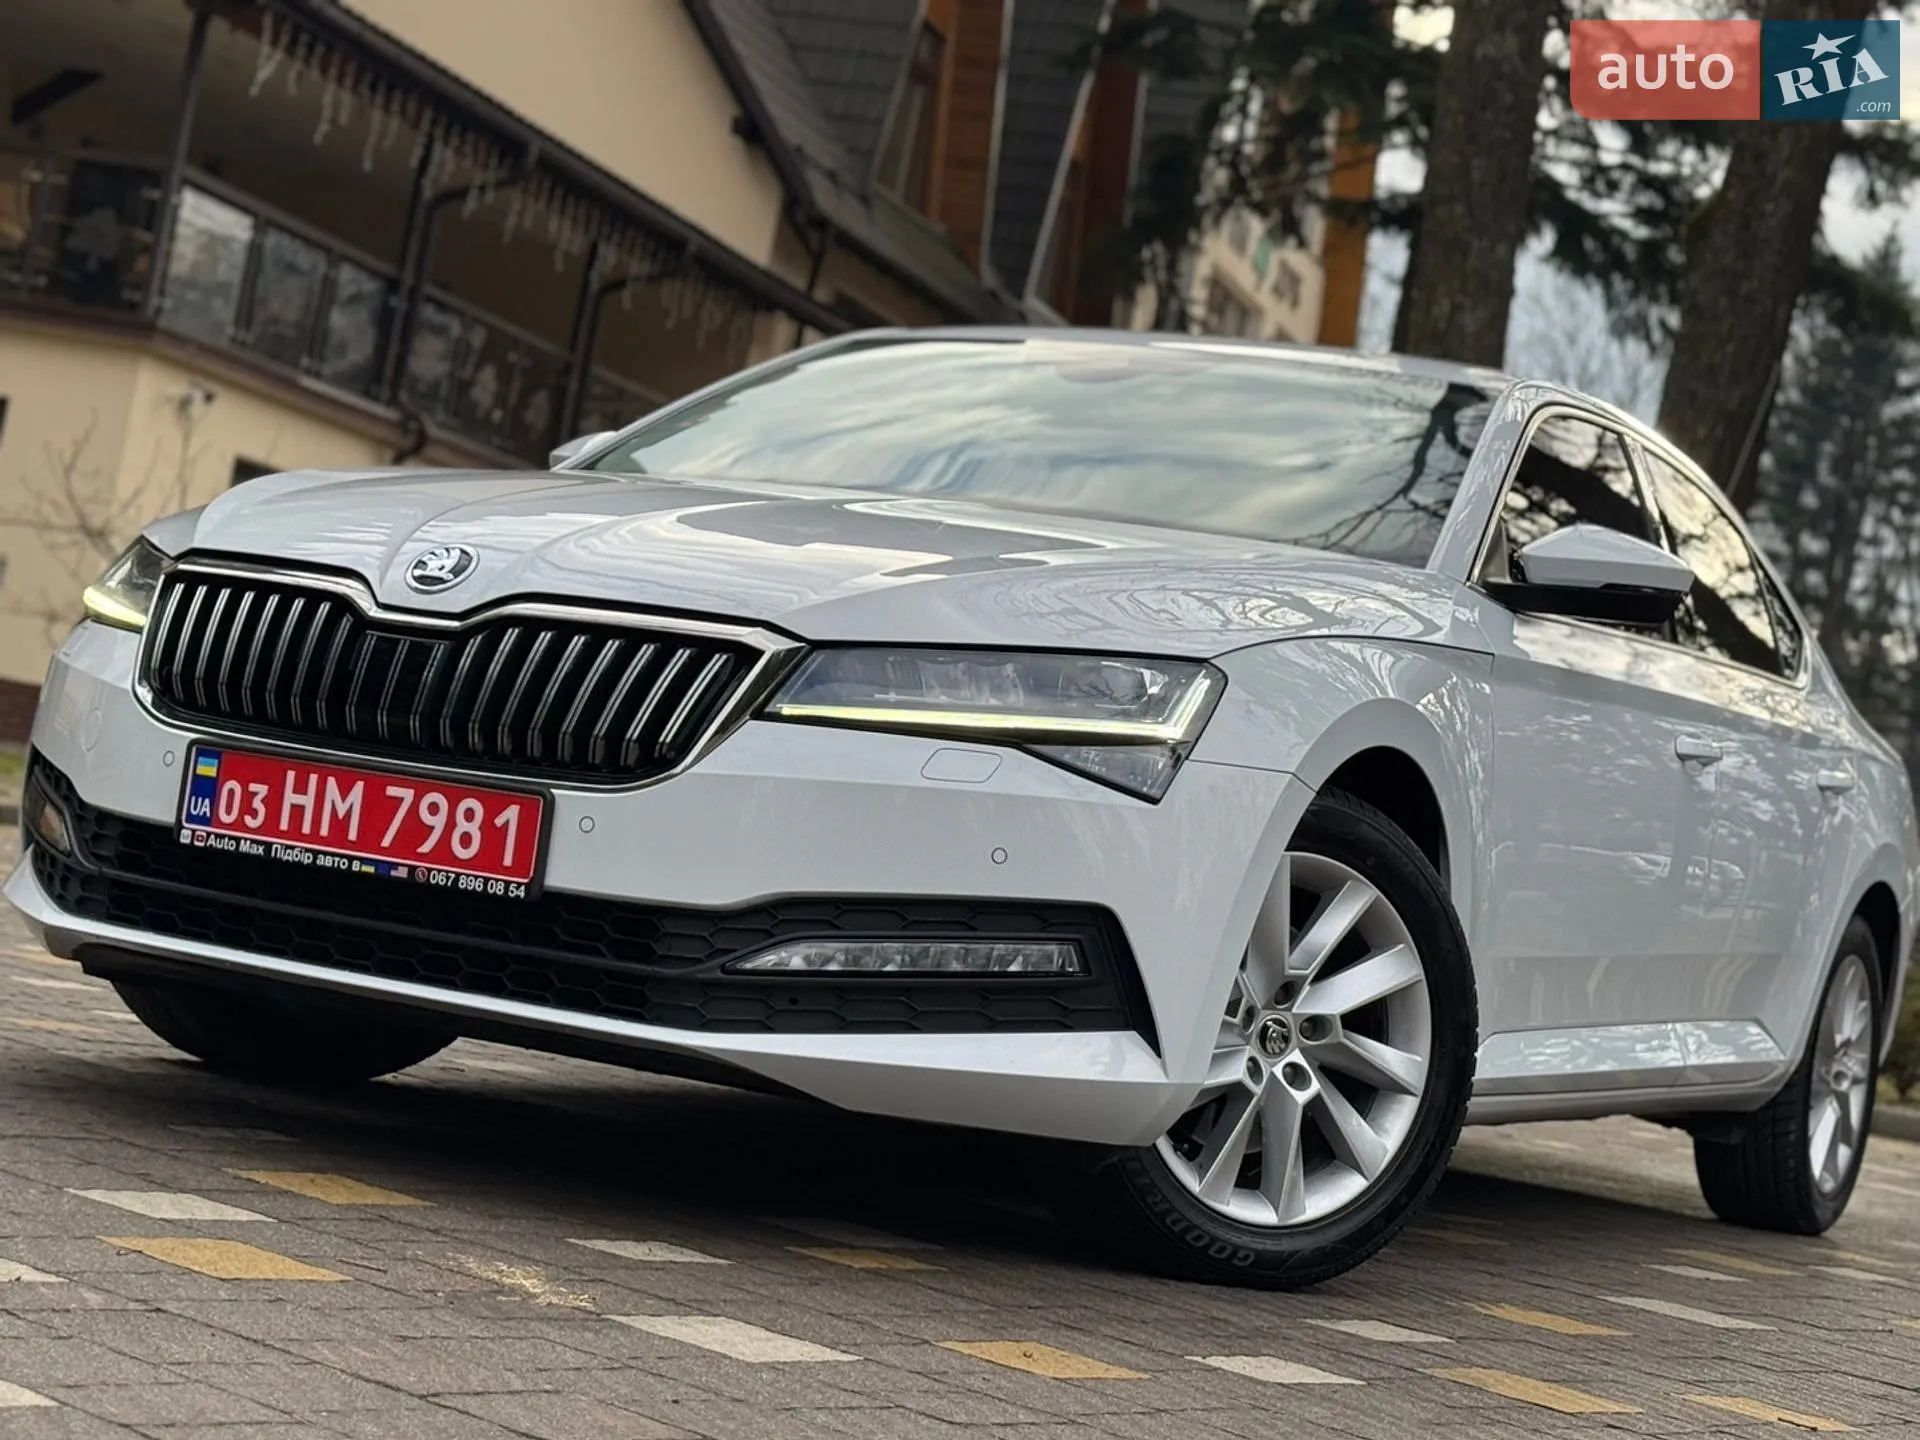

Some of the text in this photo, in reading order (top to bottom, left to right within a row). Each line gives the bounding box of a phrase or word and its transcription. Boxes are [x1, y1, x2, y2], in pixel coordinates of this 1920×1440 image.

[190, 796, 211, 817] UA
[218, 770, 520, 867] 03 HM 7981
[206, 834, 526, 899] Auto Max Підбір авто в 067 896 08 54
